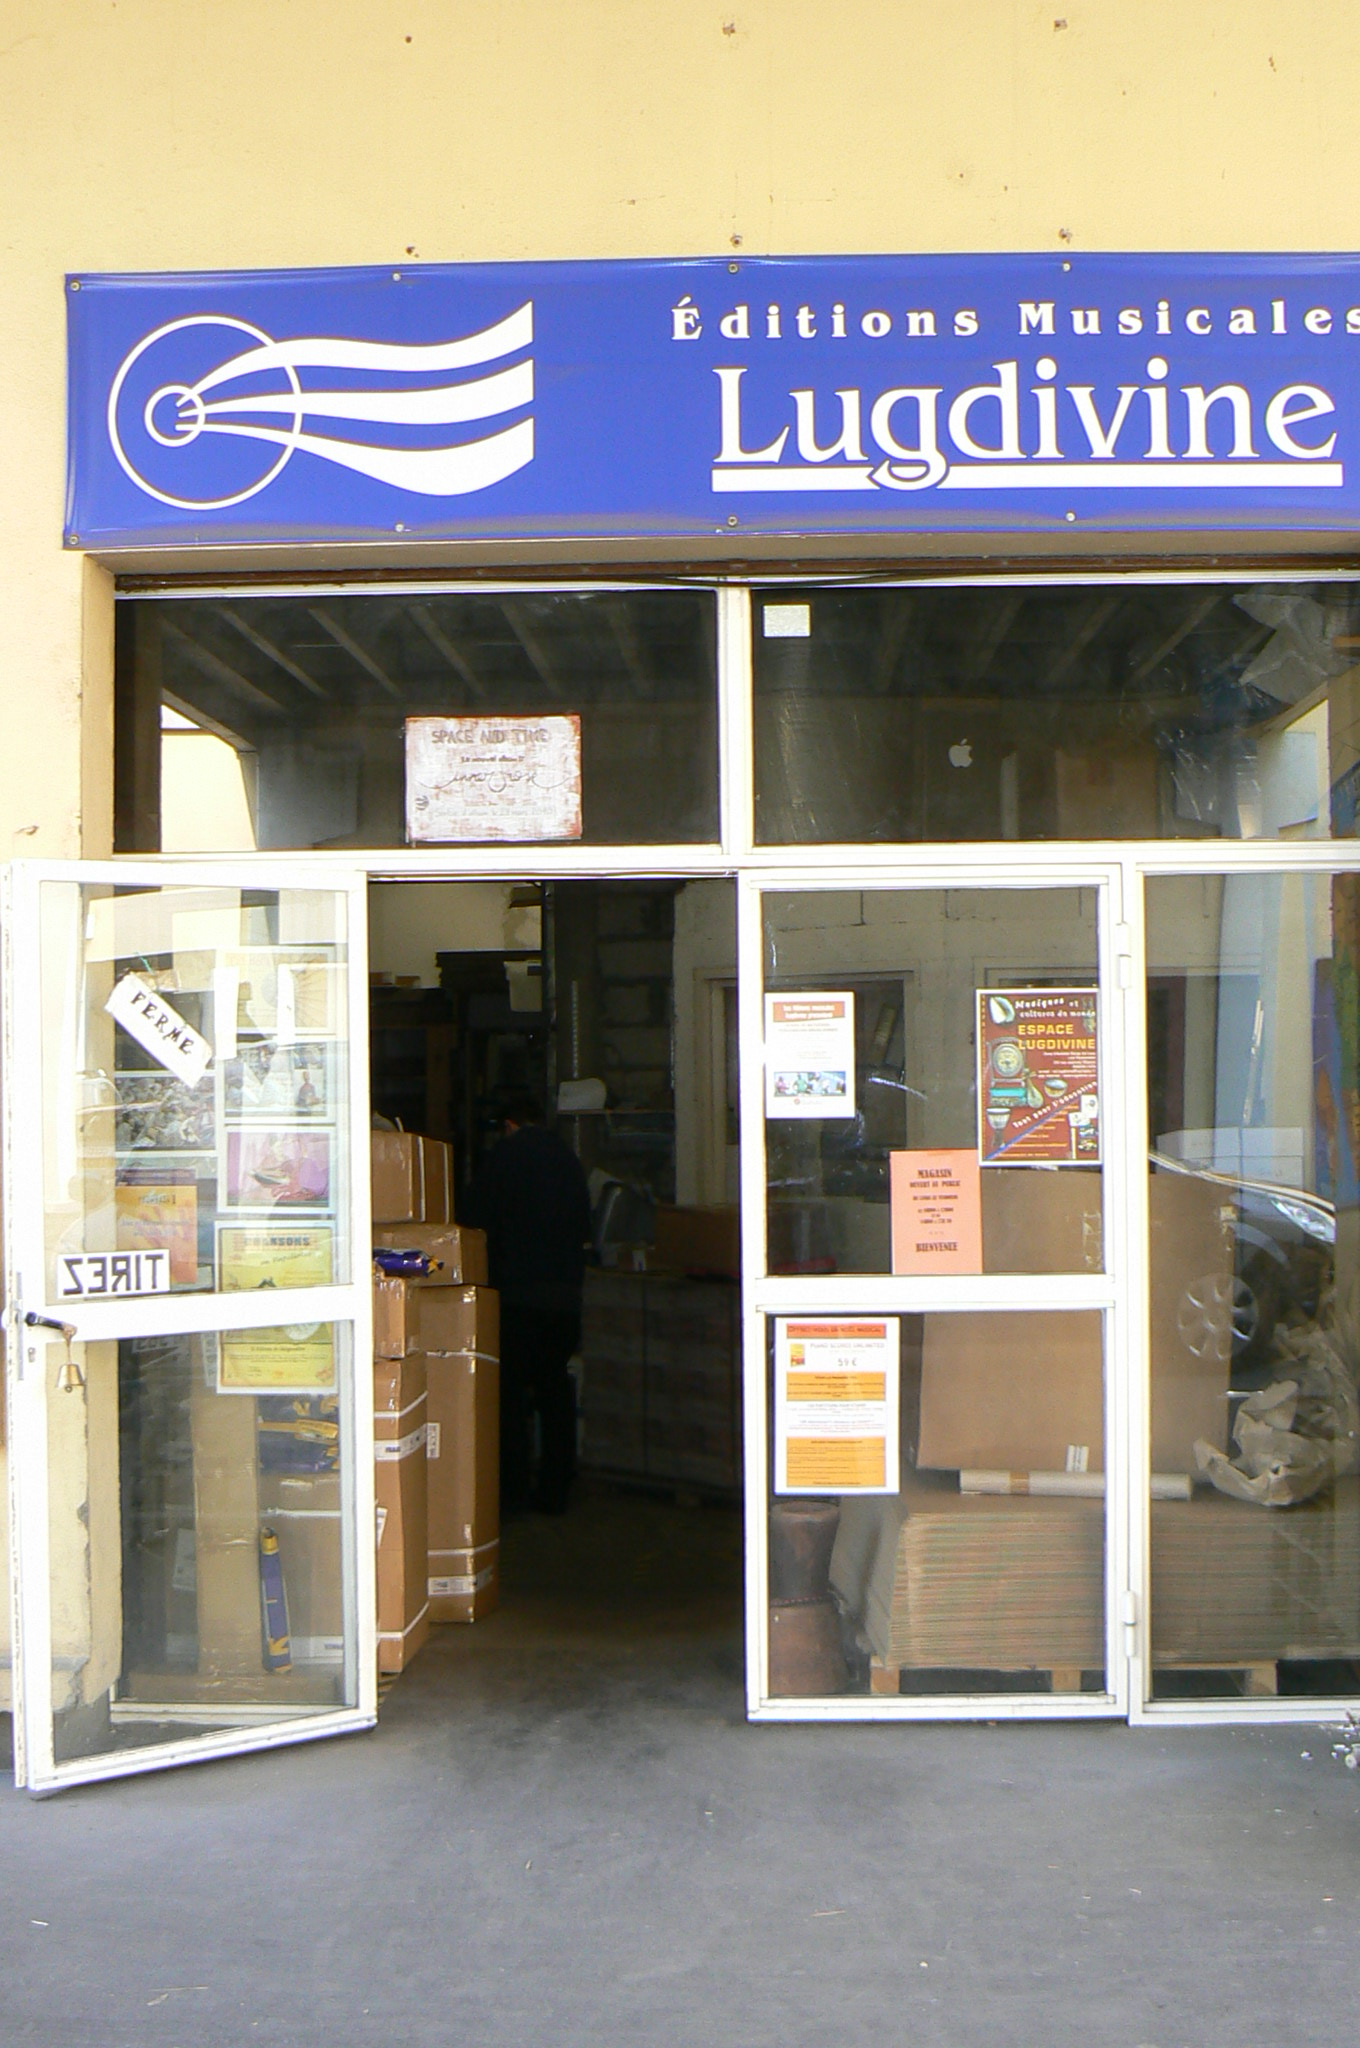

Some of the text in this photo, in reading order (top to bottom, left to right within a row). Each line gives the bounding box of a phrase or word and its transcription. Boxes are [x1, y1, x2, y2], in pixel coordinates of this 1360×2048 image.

[672, 295, 1360, 340] Éditions Musicales
[712, 357, 1338, 490] Lugdivine
[431, 728, 473, 744] SPACE
[1018, 1023, 1074, 1035] ESPACE
[1018, 1038, 1096, 1050] LUGDIVINE
[917, 1169, 952, 1178] MAGASIN
[916, 1242, 958, 1252] BIENVENUE
